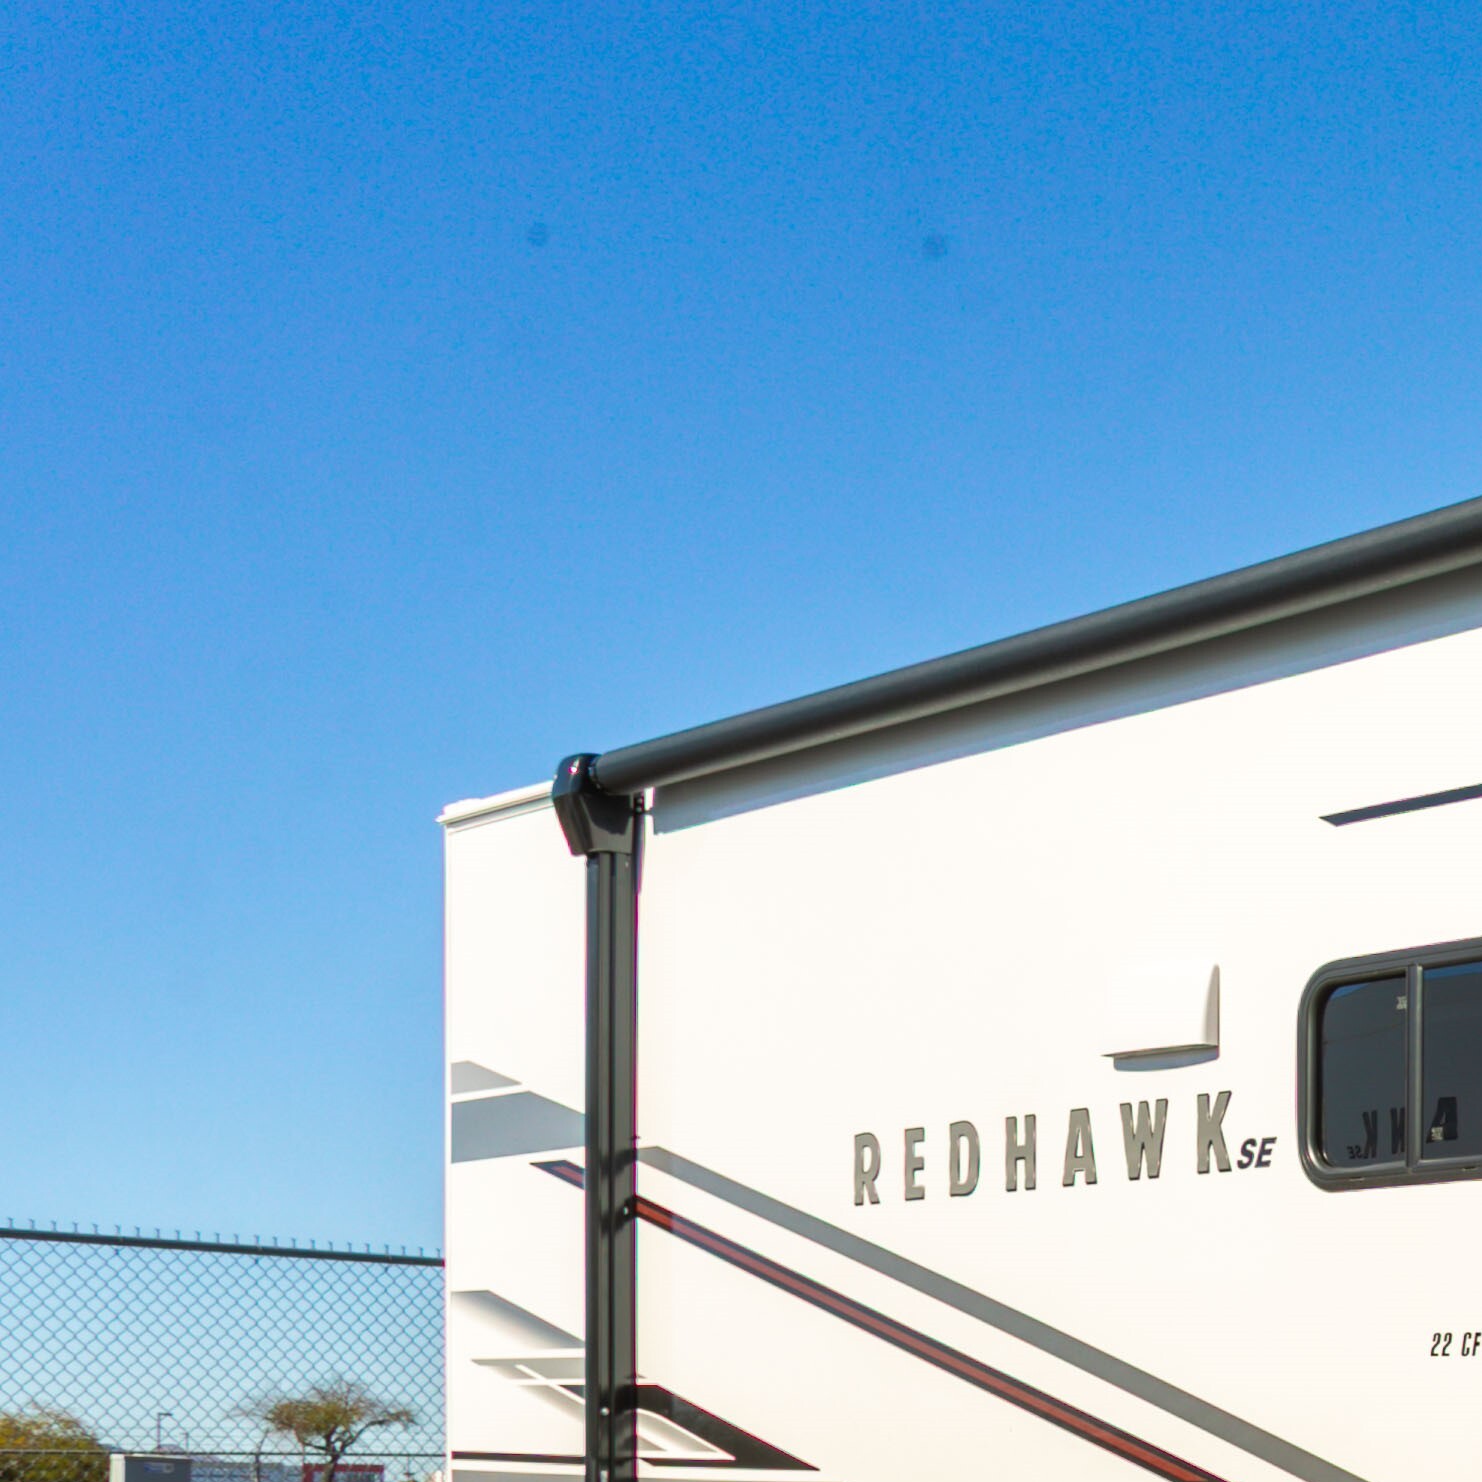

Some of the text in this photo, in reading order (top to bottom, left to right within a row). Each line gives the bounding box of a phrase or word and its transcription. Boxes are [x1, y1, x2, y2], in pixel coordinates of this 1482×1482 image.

[853, 1090, 1278, 1206] REDHAWK SE
[1430, 1331, 1453, 1357] 22
[1461, 1331, 1482, 1357] CF
